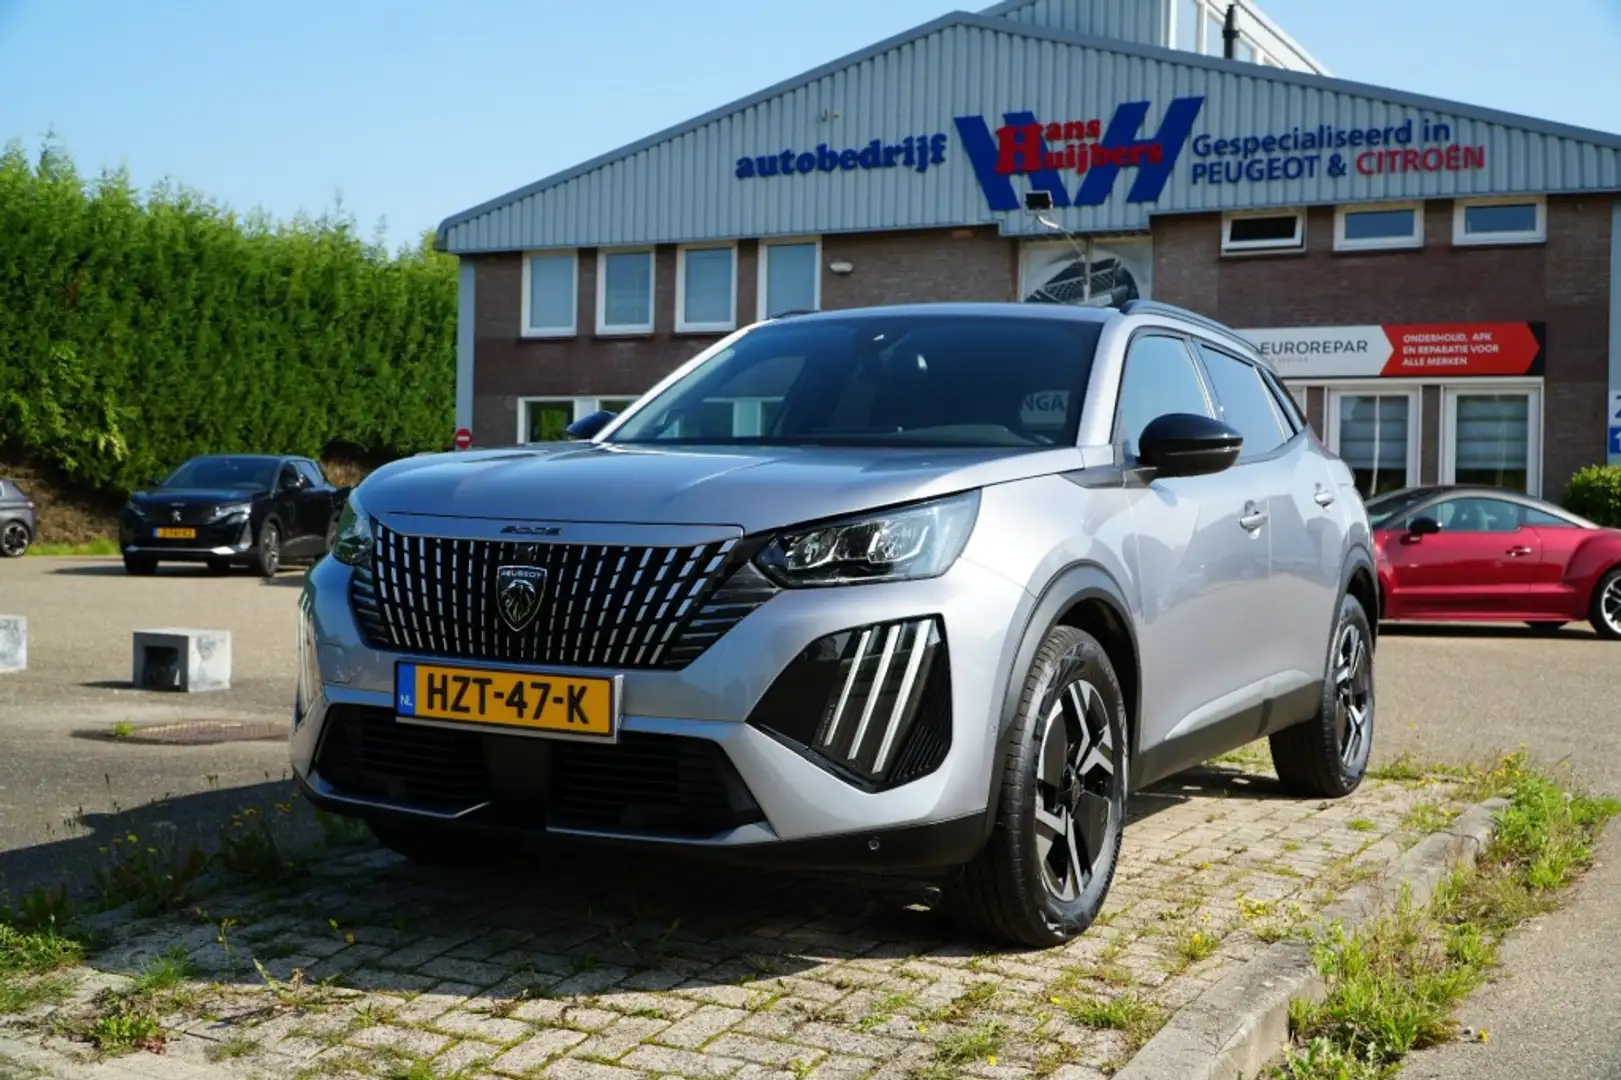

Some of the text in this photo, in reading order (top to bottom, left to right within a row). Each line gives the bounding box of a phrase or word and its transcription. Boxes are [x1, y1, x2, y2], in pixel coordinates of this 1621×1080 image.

[1192, 119, 1451, 158] Gespecialiseerd in
[735, 133, 947, 179] autobedrijf
[1191, 144, 1485, 185] PEUGEOT & CITROËN
[1472, 332, 1492, 341] APK
[1260, 340, 1368, 355] EUROREPAR
[1403, 344, 1499, 354] EN REPARATIE VOOR
[1403, 357, 1467, 366] ALLE MERKEN
[400, 694, 413, 706] NL
[427, 672, 589, 724] HZT-47-K
